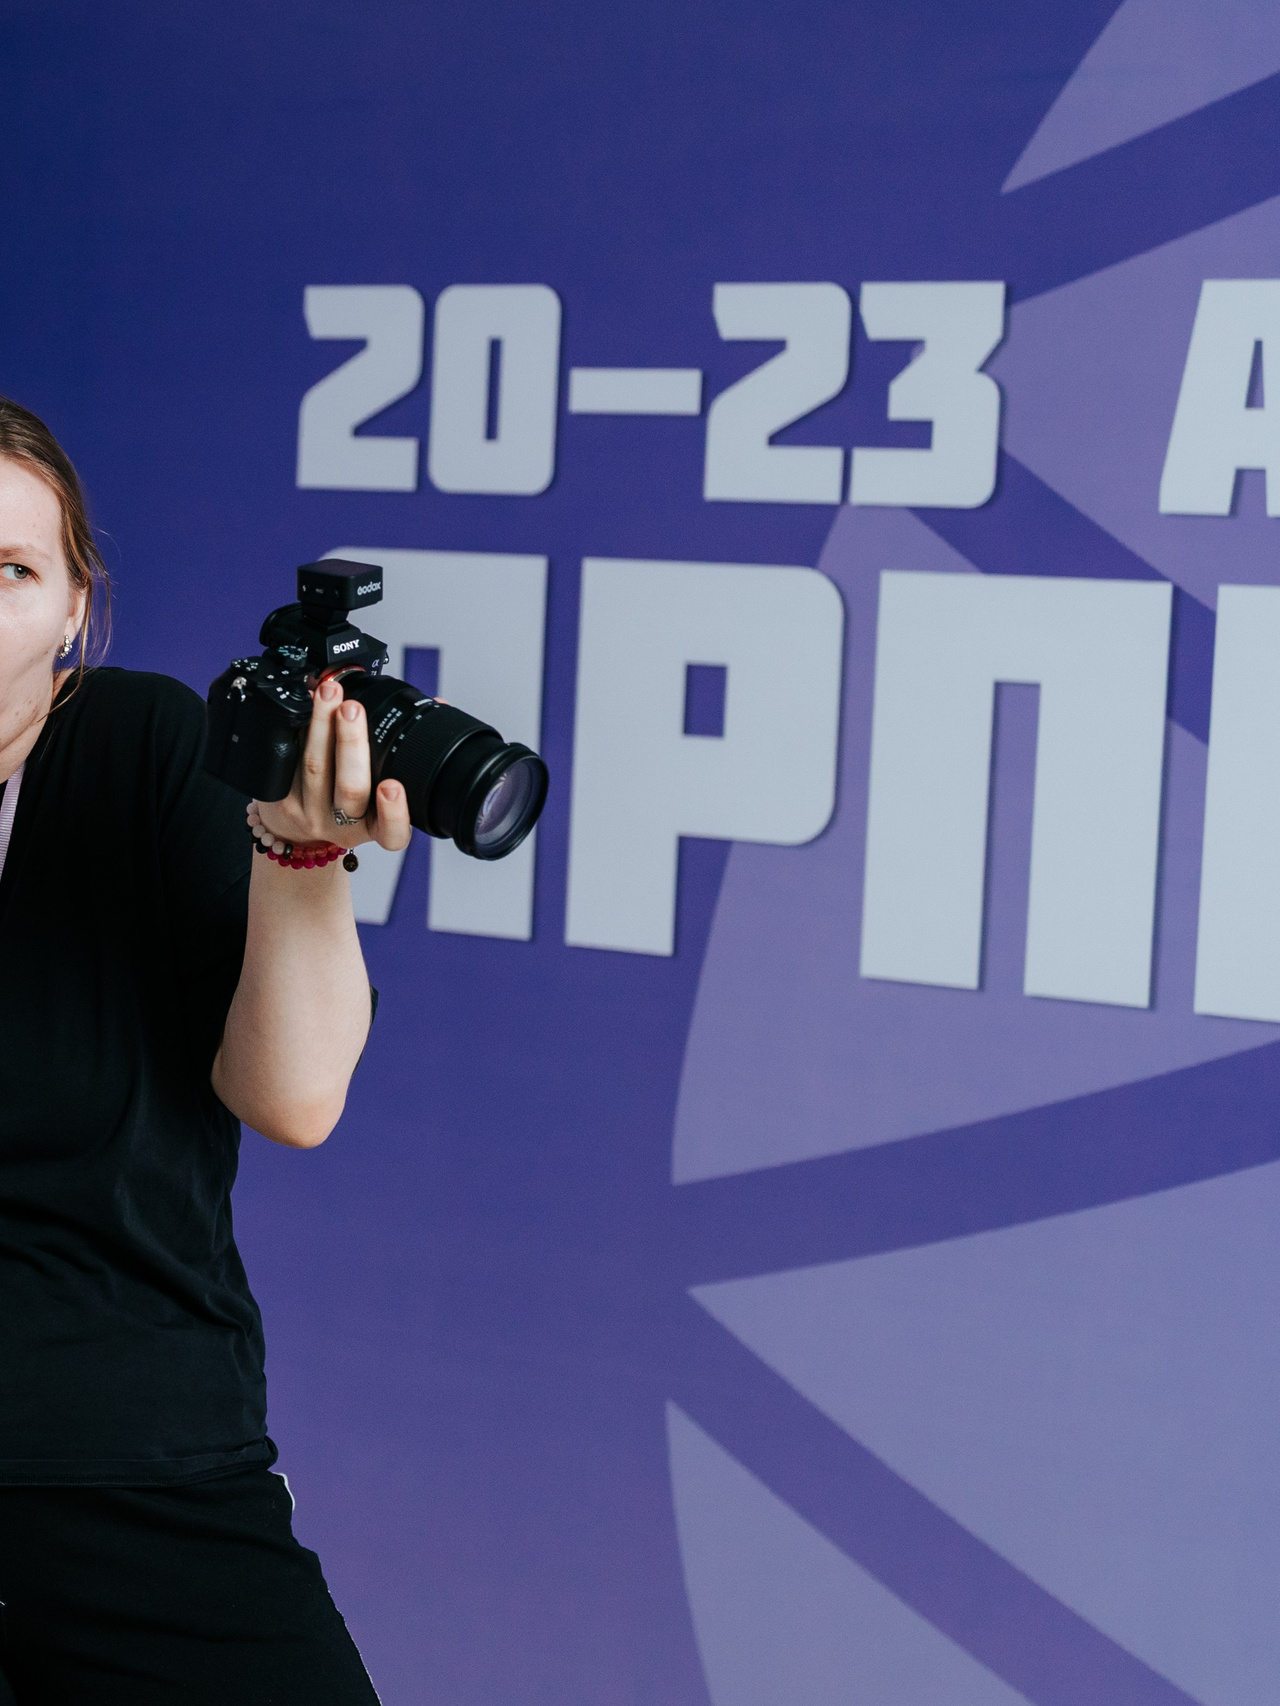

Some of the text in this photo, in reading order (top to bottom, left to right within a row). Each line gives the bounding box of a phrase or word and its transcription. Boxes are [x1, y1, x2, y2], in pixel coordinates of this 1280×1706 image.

[357, 581, 381, 596] Godox
[332, 639, 360, 654] SONY
[302, 545, 1280, 1024] ЯРП
